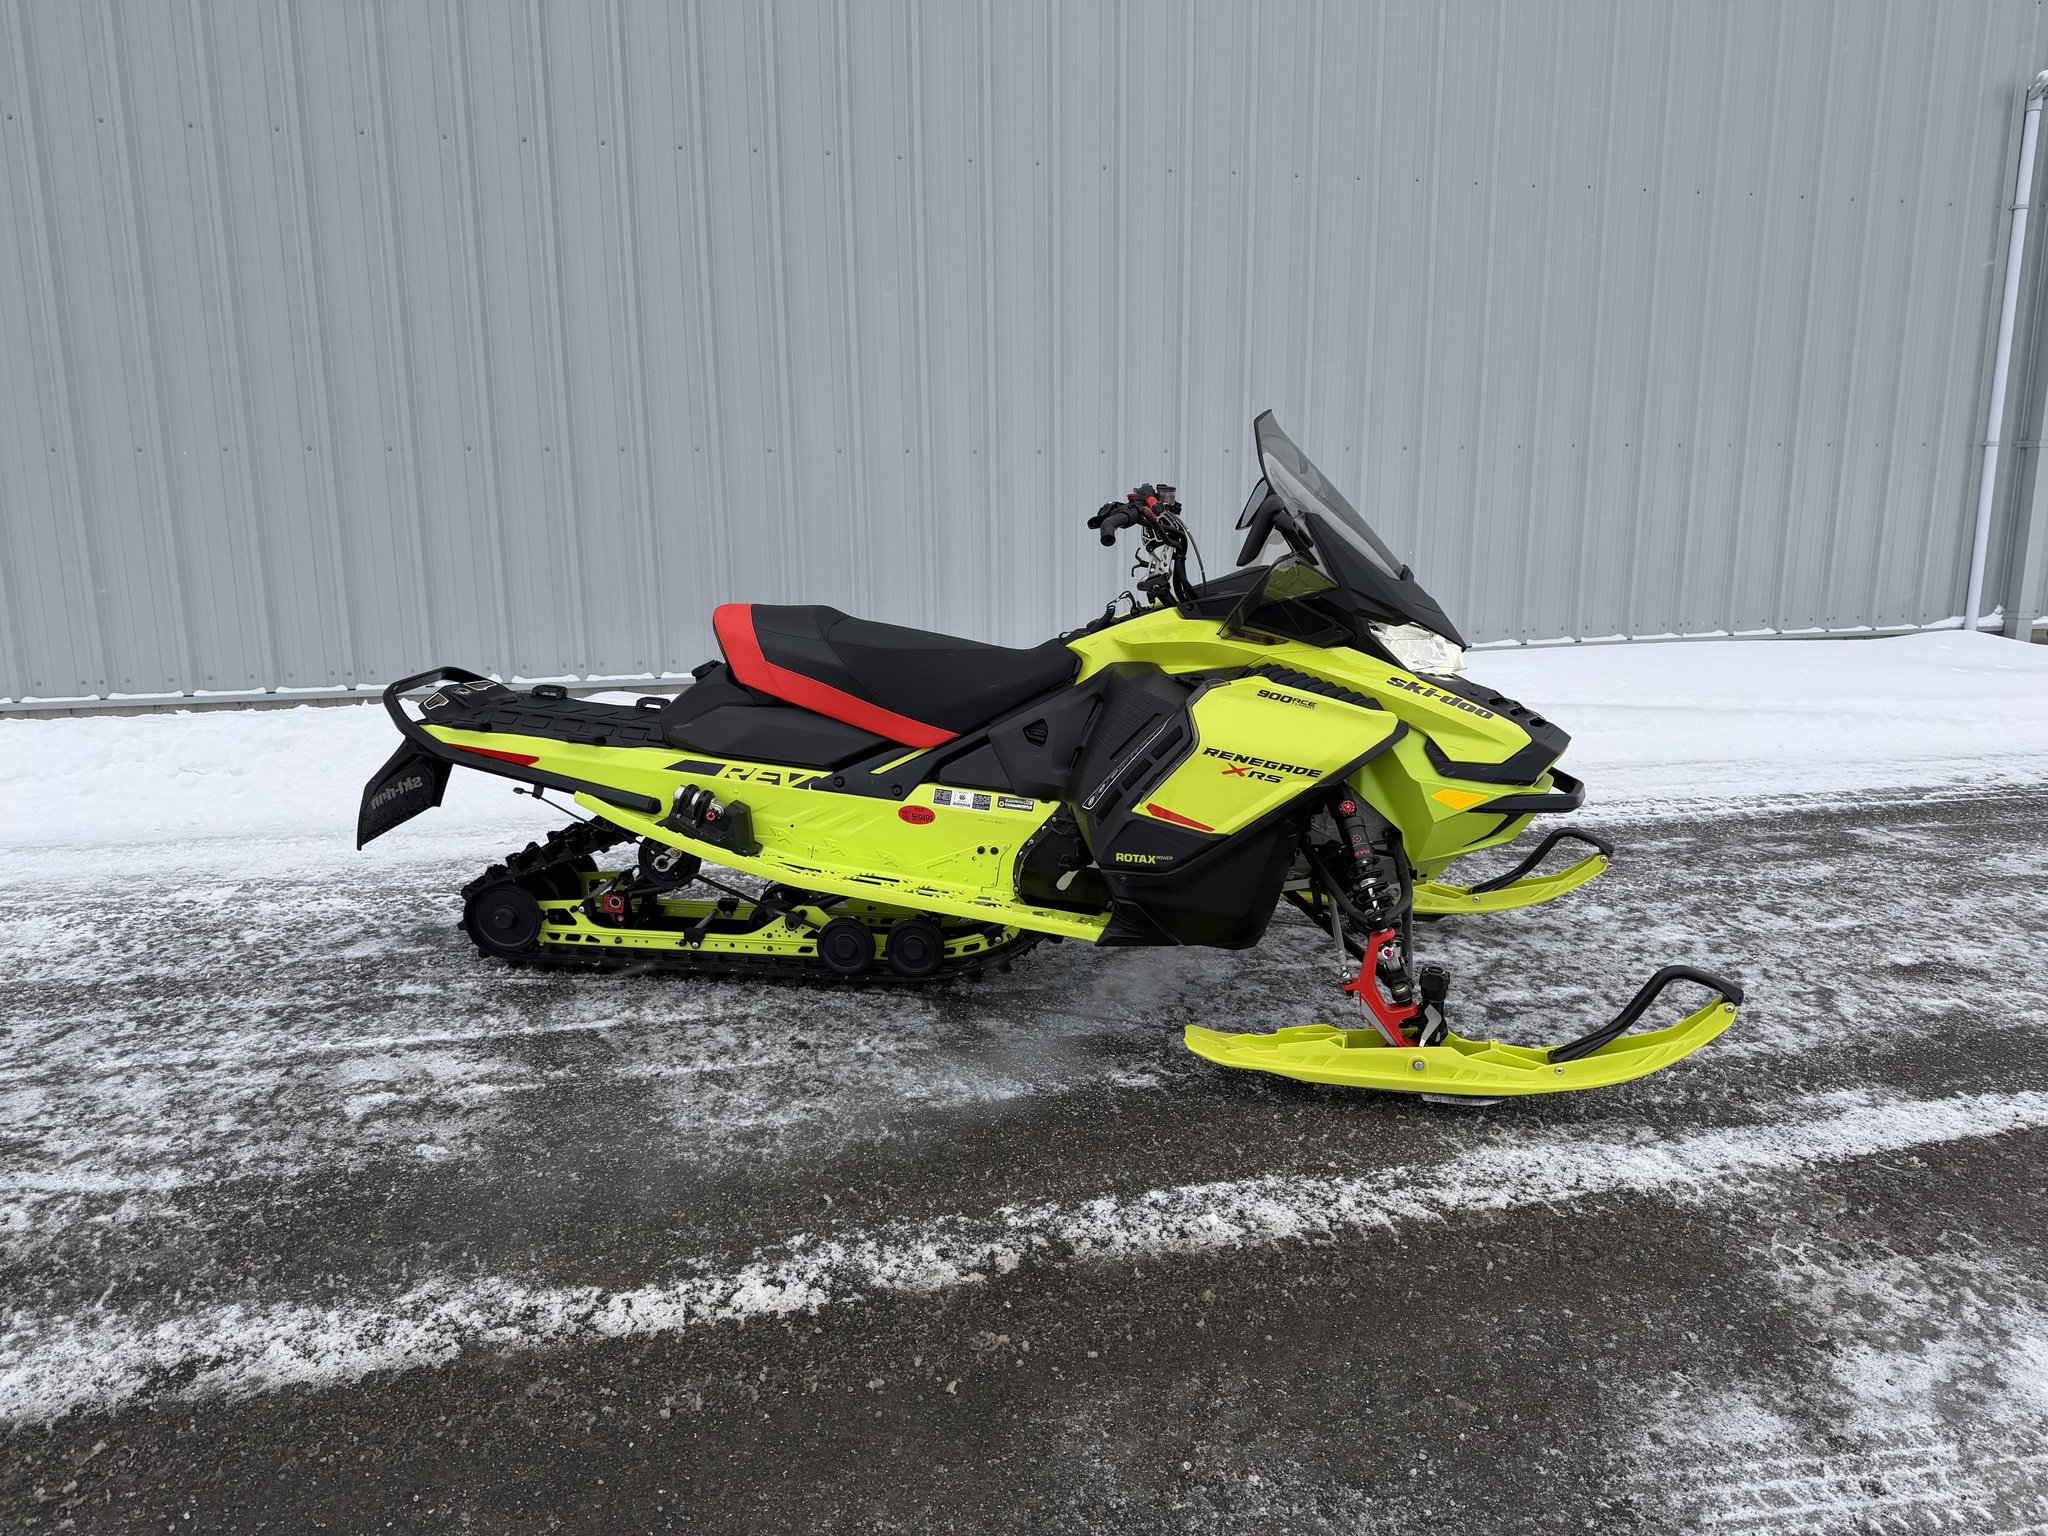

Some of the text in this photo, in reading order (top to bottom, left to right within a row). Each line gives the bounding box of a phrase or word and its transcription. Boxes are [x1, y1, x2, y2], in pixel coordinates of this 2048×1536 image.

[1256, 689, 1294, 704] 900
[1386, 676, 1495, 720] ski-doo
[1202, 746, 1323, 778] RENEGADE
[1115, 852, 1156, 864] ROTAX
